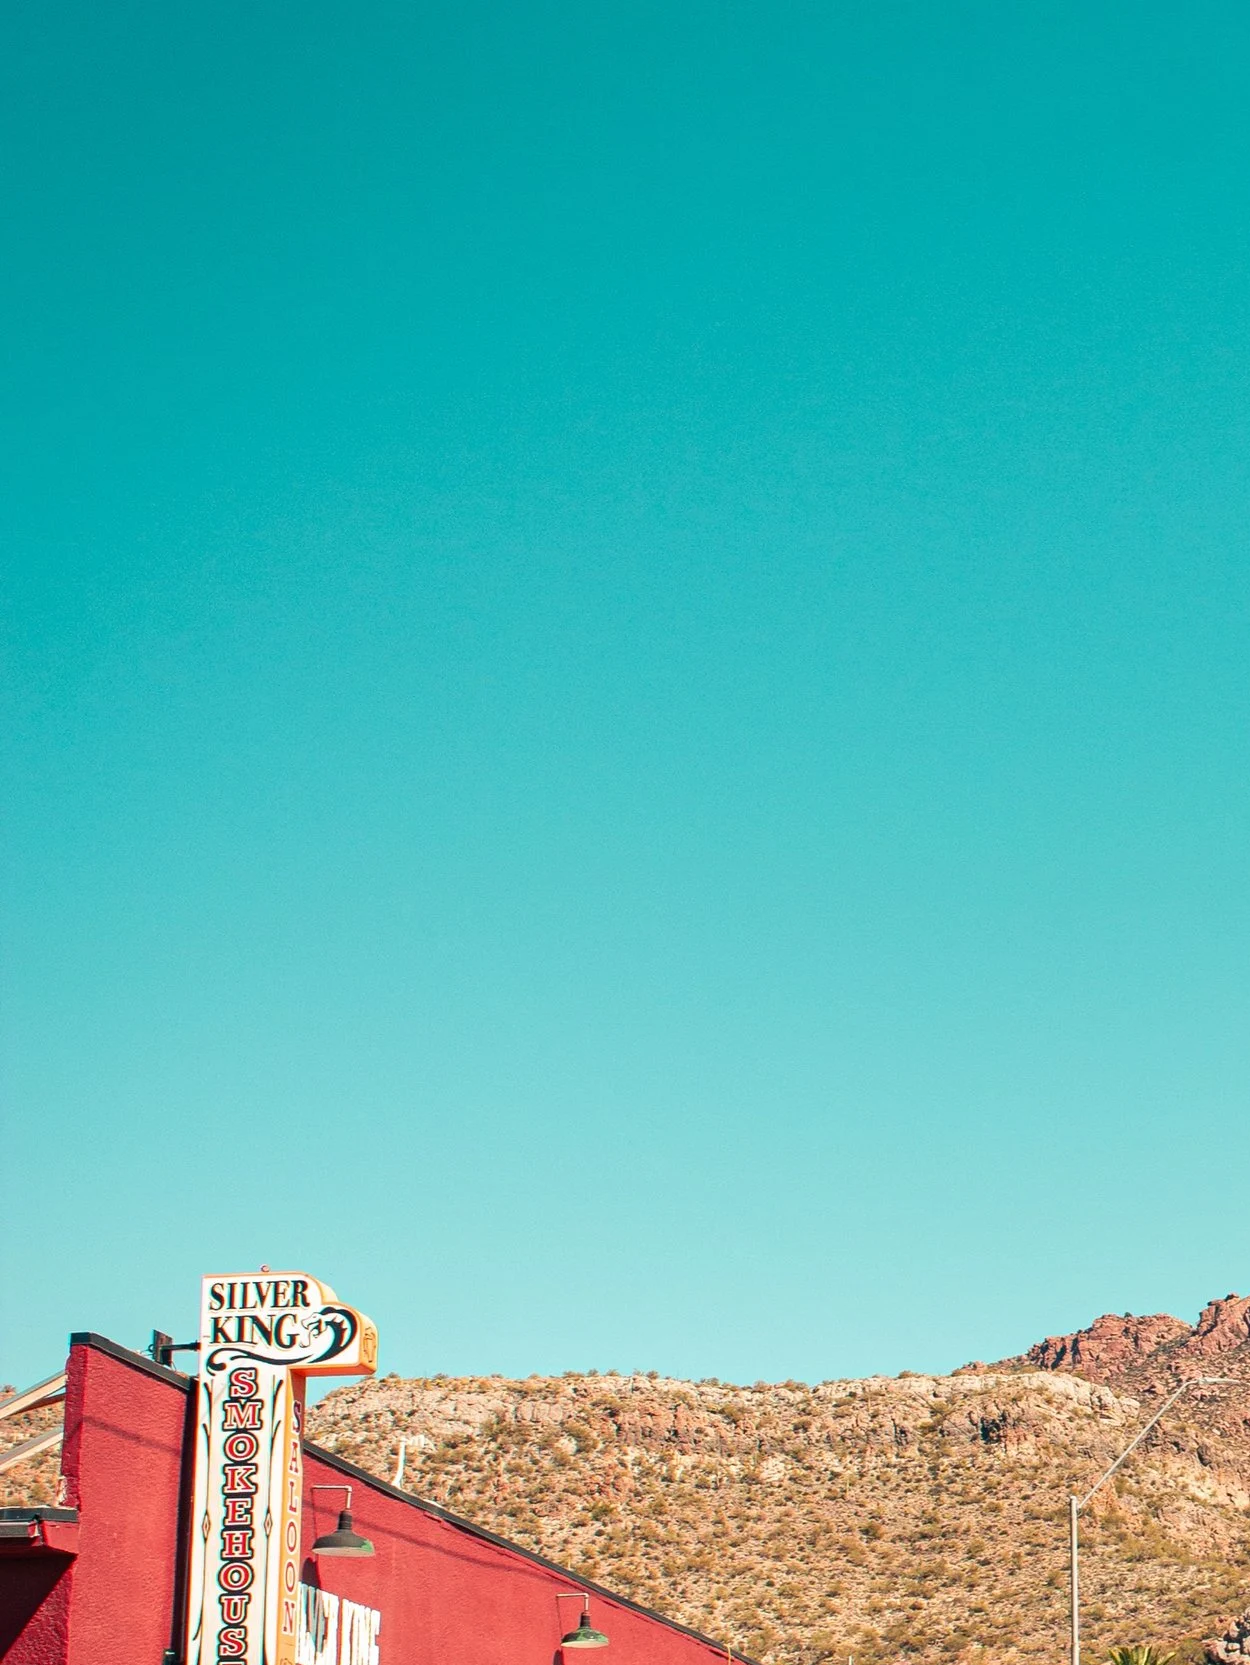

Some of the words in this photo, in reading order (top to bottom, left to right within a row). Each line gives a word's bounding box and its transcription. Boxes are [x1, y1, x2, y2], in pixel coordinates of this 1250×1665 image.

[209, 1280, 311, 1311] SILVER
[210, 1313, 300, 1349] KING
[282, 1400, 303, 1635] SALOON
